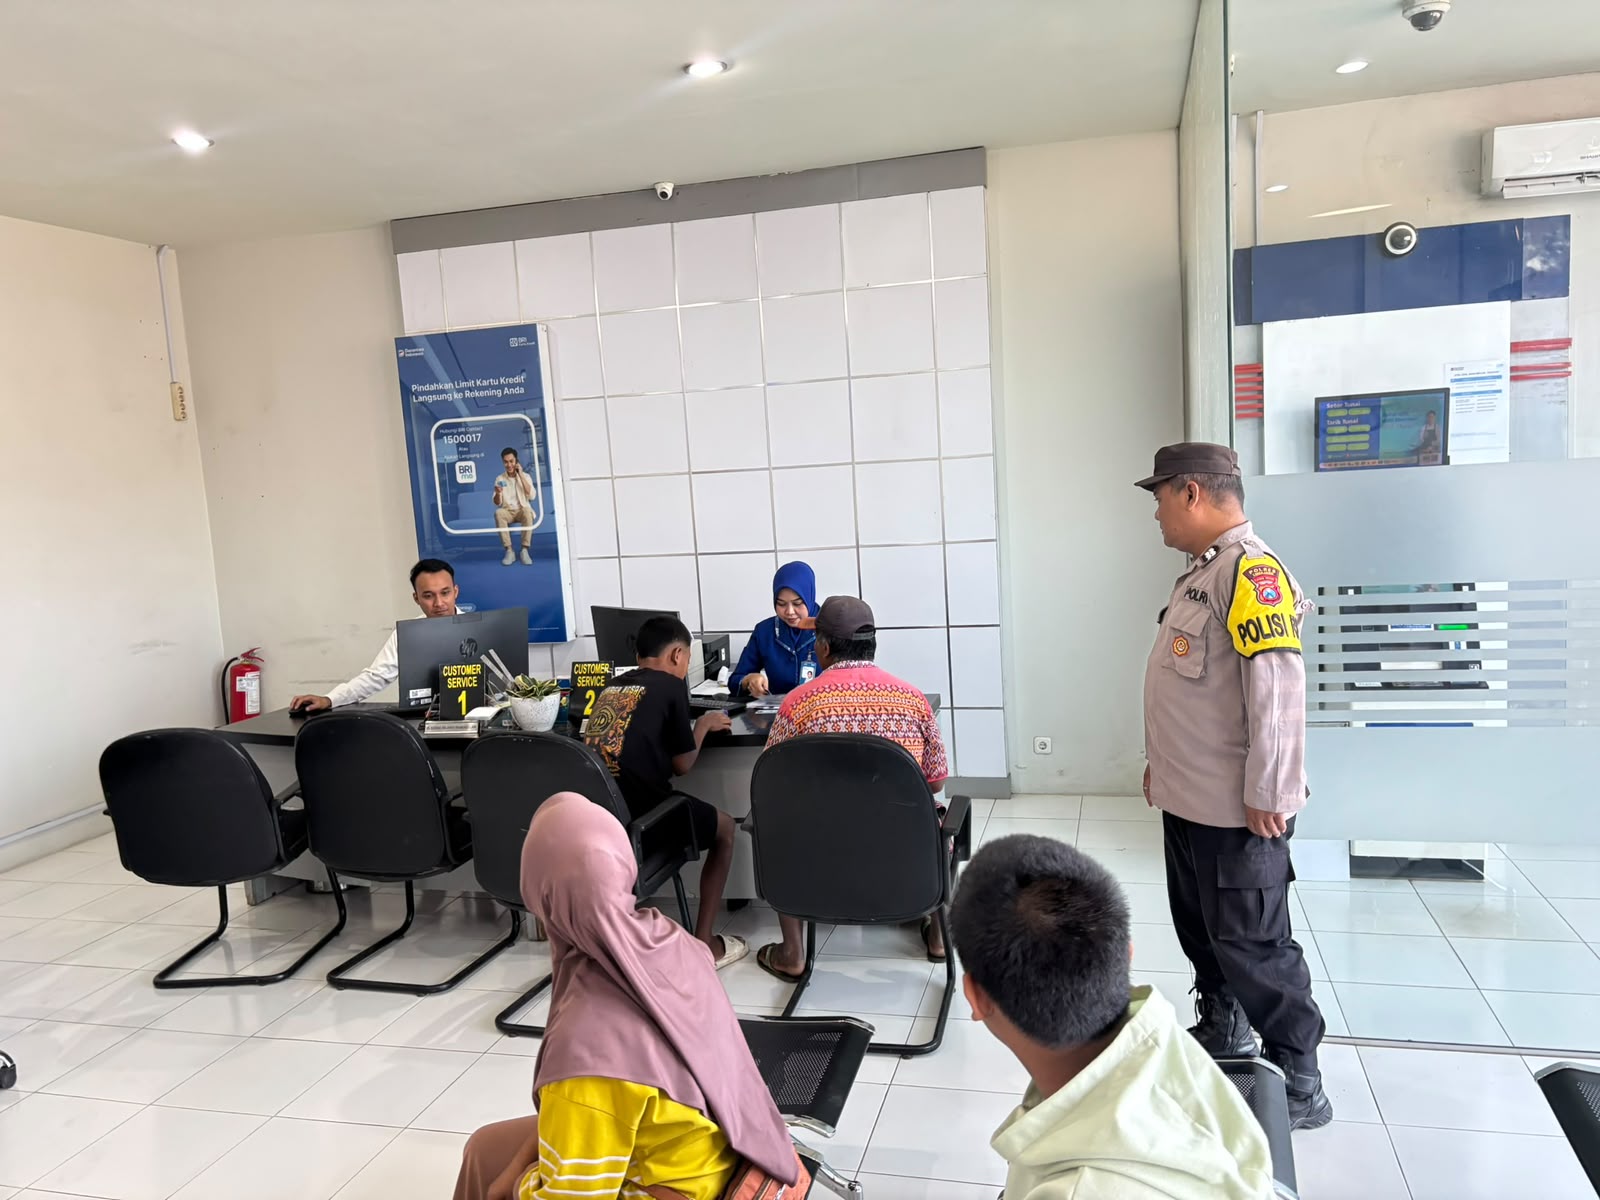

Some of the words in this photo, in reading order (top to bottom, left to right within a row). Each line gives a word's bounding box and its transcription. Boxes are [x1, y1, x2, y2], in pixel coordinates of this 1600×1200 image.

[411, 382, 454, 392] Pindahkan
[455, 379, 475, 389] Limit
[476, 378, 499, 387] Kartu
[500, 375, 525, 385] Kredit
[412, 393, 453, 403] Langsung
[454, 391, 464, 399] ke
[465, 388, 502, 399] Rekening
[503, 386, 525, 395] Anda
[443, 433, 481, 444] 1500017
[458, 465, 473, 474] BRI
[1249, 567, 1276, 575] POLRES
[1184, 587, 1208, 605] POLRI
[1237, 613, 1288, 647] POLISI
[442, 663, 482, 677] CUSTOMER
[574, 663, 610, 675] CUSTOMER
[447, 676, 478, 689] SERVICE
[577, 675, 606, 687] SERVICE
[457, 690, 467, 716] 1
[583, 689, 596, 715] 2
